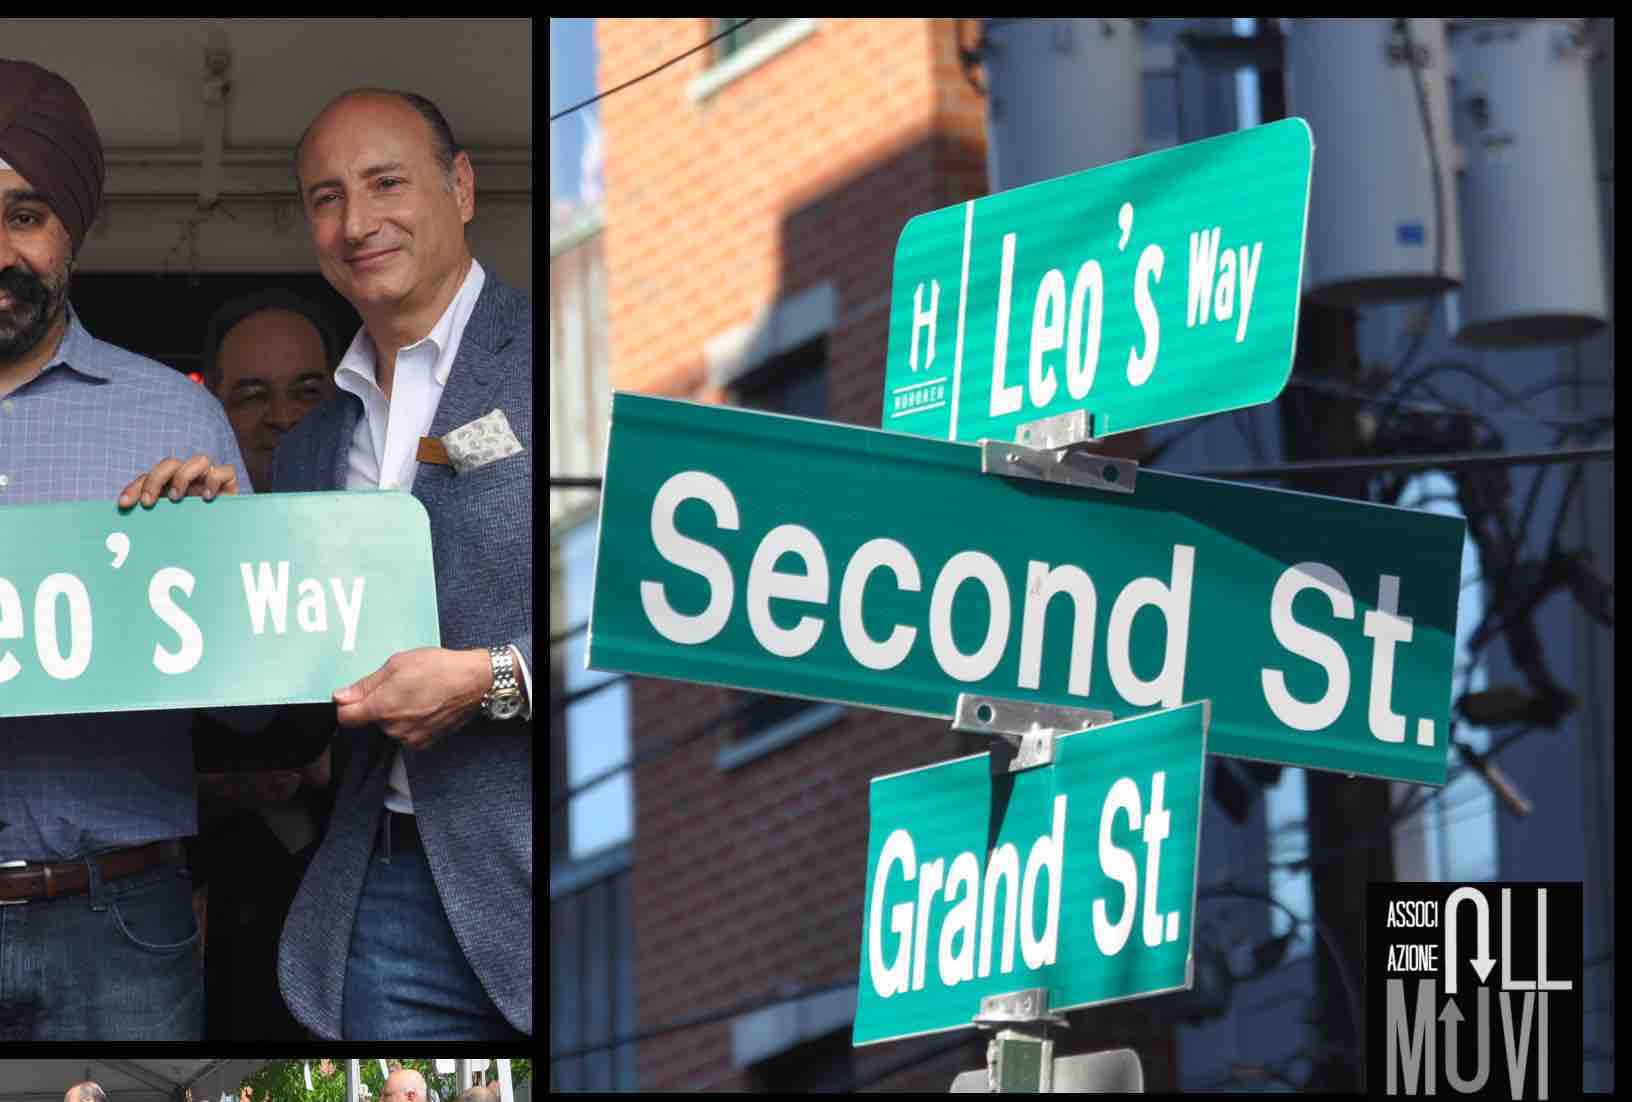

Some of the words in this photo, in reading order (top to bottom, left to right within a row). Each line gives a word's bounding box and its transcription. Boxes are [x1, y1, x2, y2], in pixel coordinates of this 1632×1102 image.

[908, 279, 940, 373] H
[988, 203, 1165, 418] Leo's
[1186, 226, 1263, 343] Way
[239, 561, 365, 653] Way
[640, 471, 1196, 708] Second
[1261, 561, 1436, 748] St.
[869, 793, 1068, 998] Grand
[1091, 771, 1181, 957] St.
